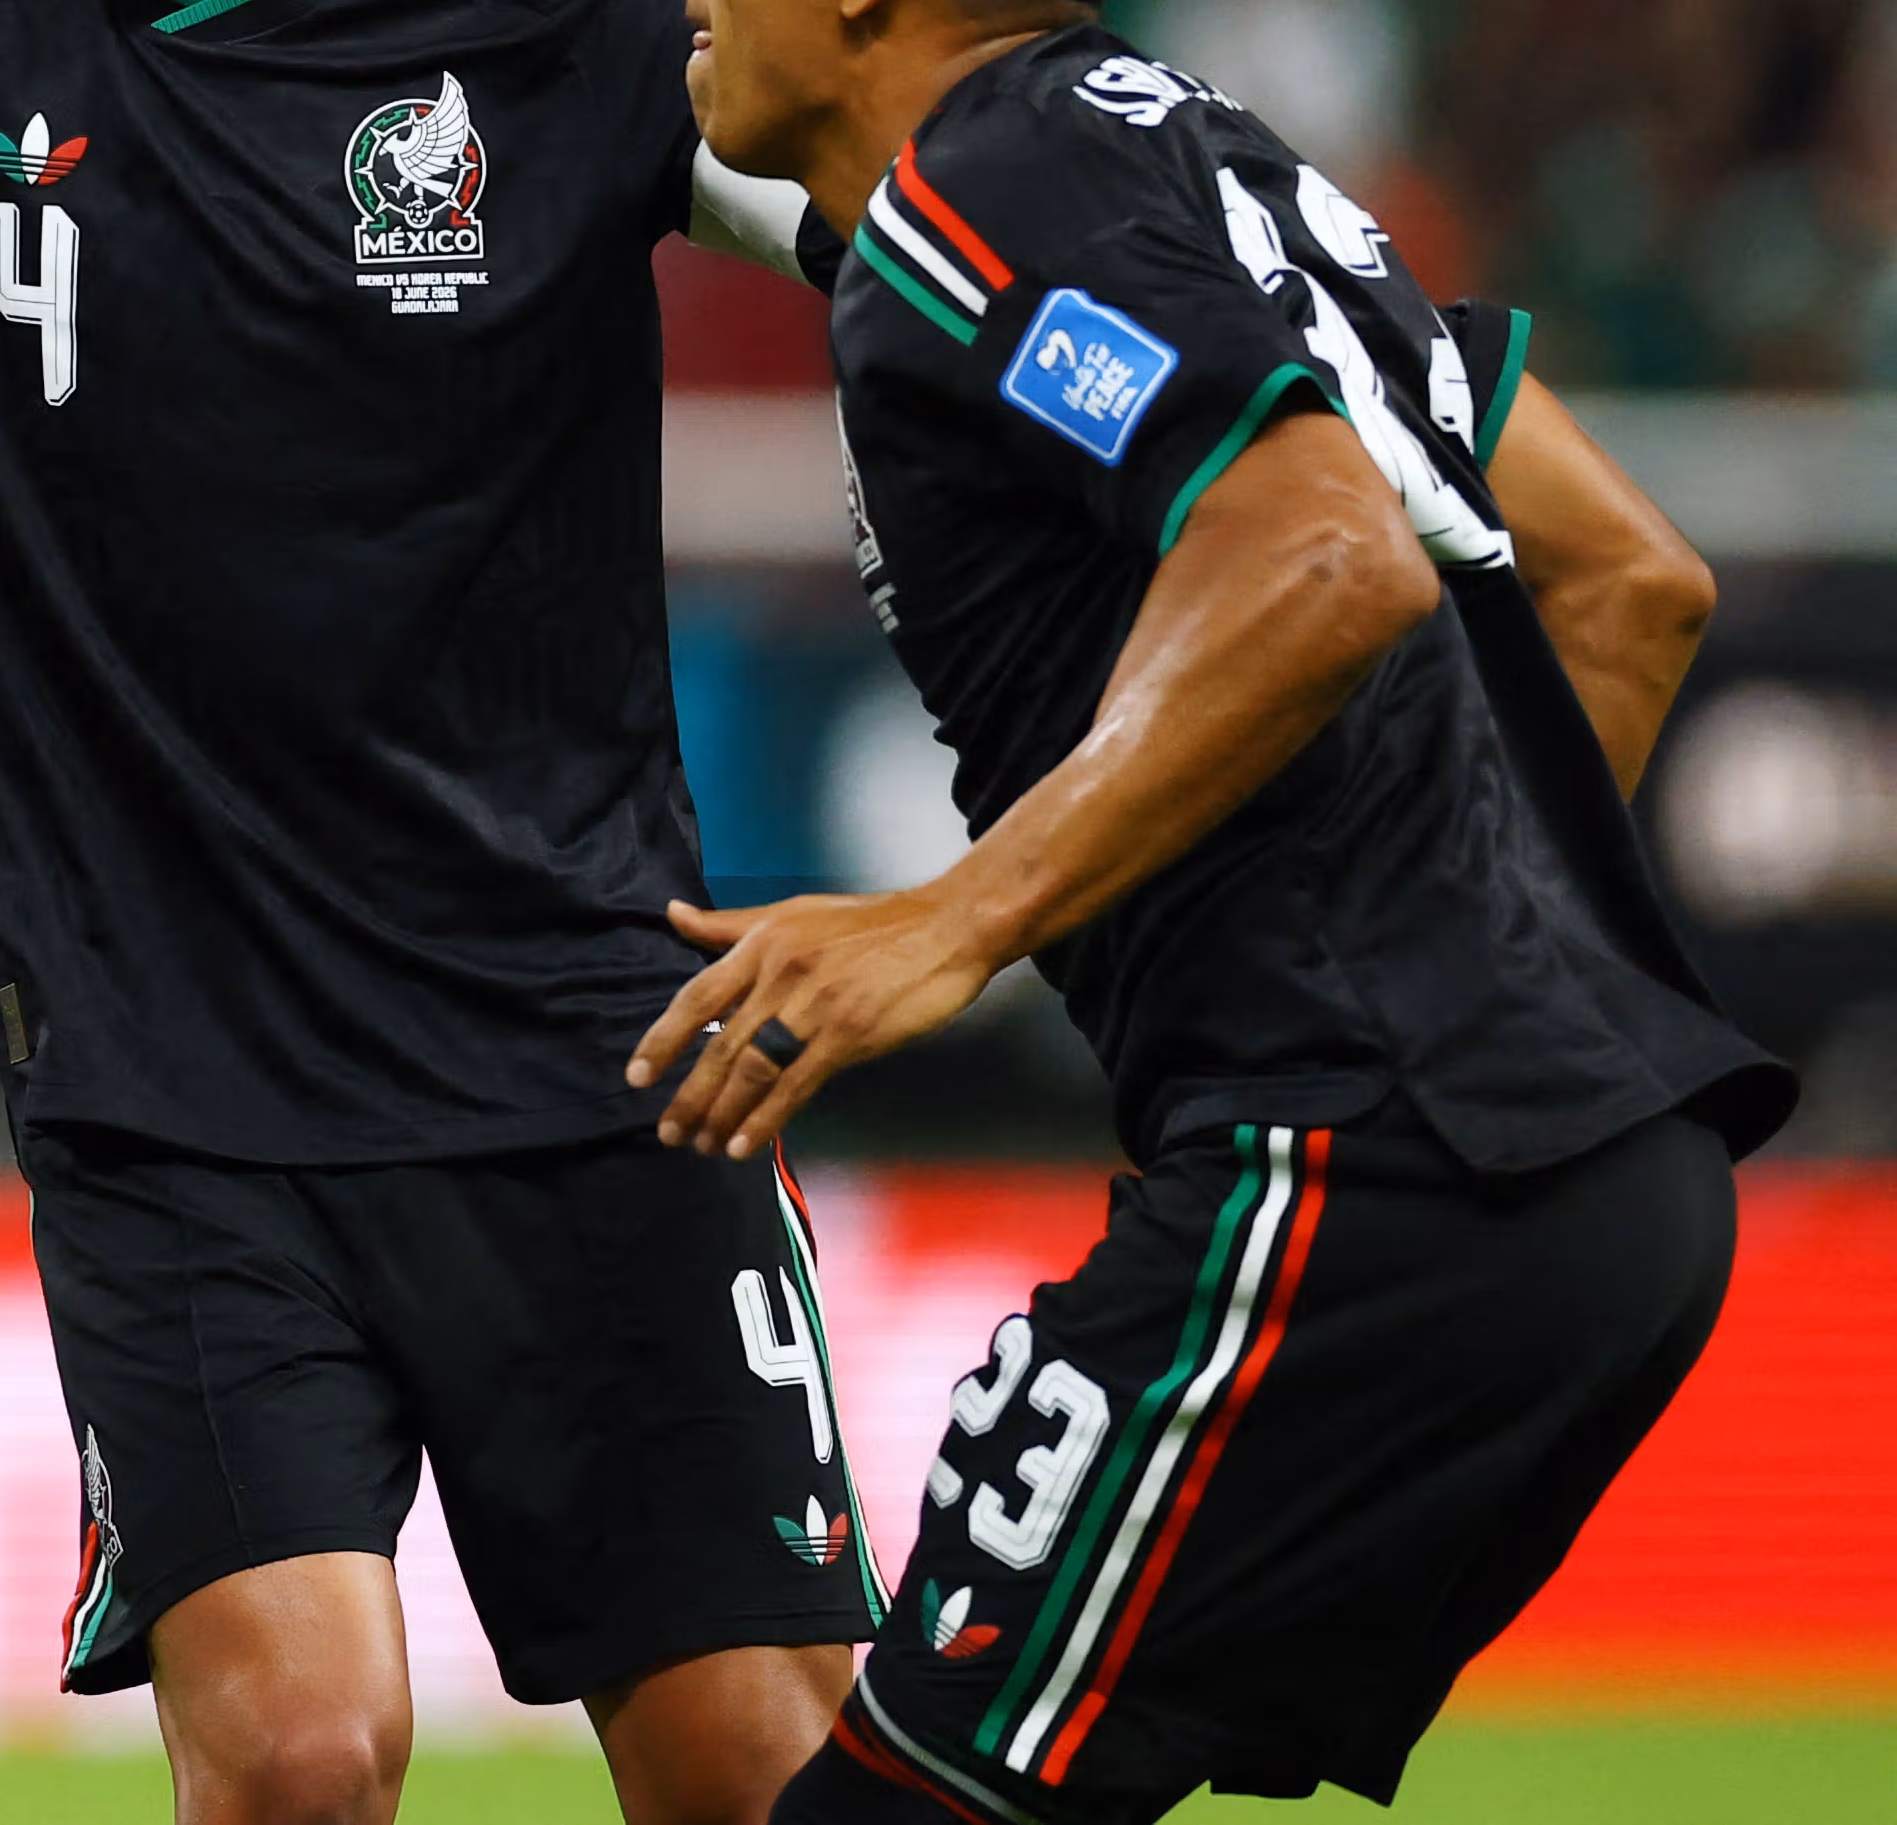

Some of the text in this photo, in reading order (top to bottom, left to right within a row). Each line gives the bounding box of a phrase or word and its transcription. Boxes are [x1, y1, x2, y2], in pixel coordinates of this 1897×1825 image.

[362, 226, 477, 256] MÉXICO
[356, 272, 490, 287] MEXICO VS KOREA REPUBLIC
[404, 286, 430, 299] JUNE
[431, 286, 458, 299] 2026
[391, 300, 459, 314] GUADALAJARA
[731, 1266, 833, 1464] 4
[926, 1316, 1110, 1571] 23
